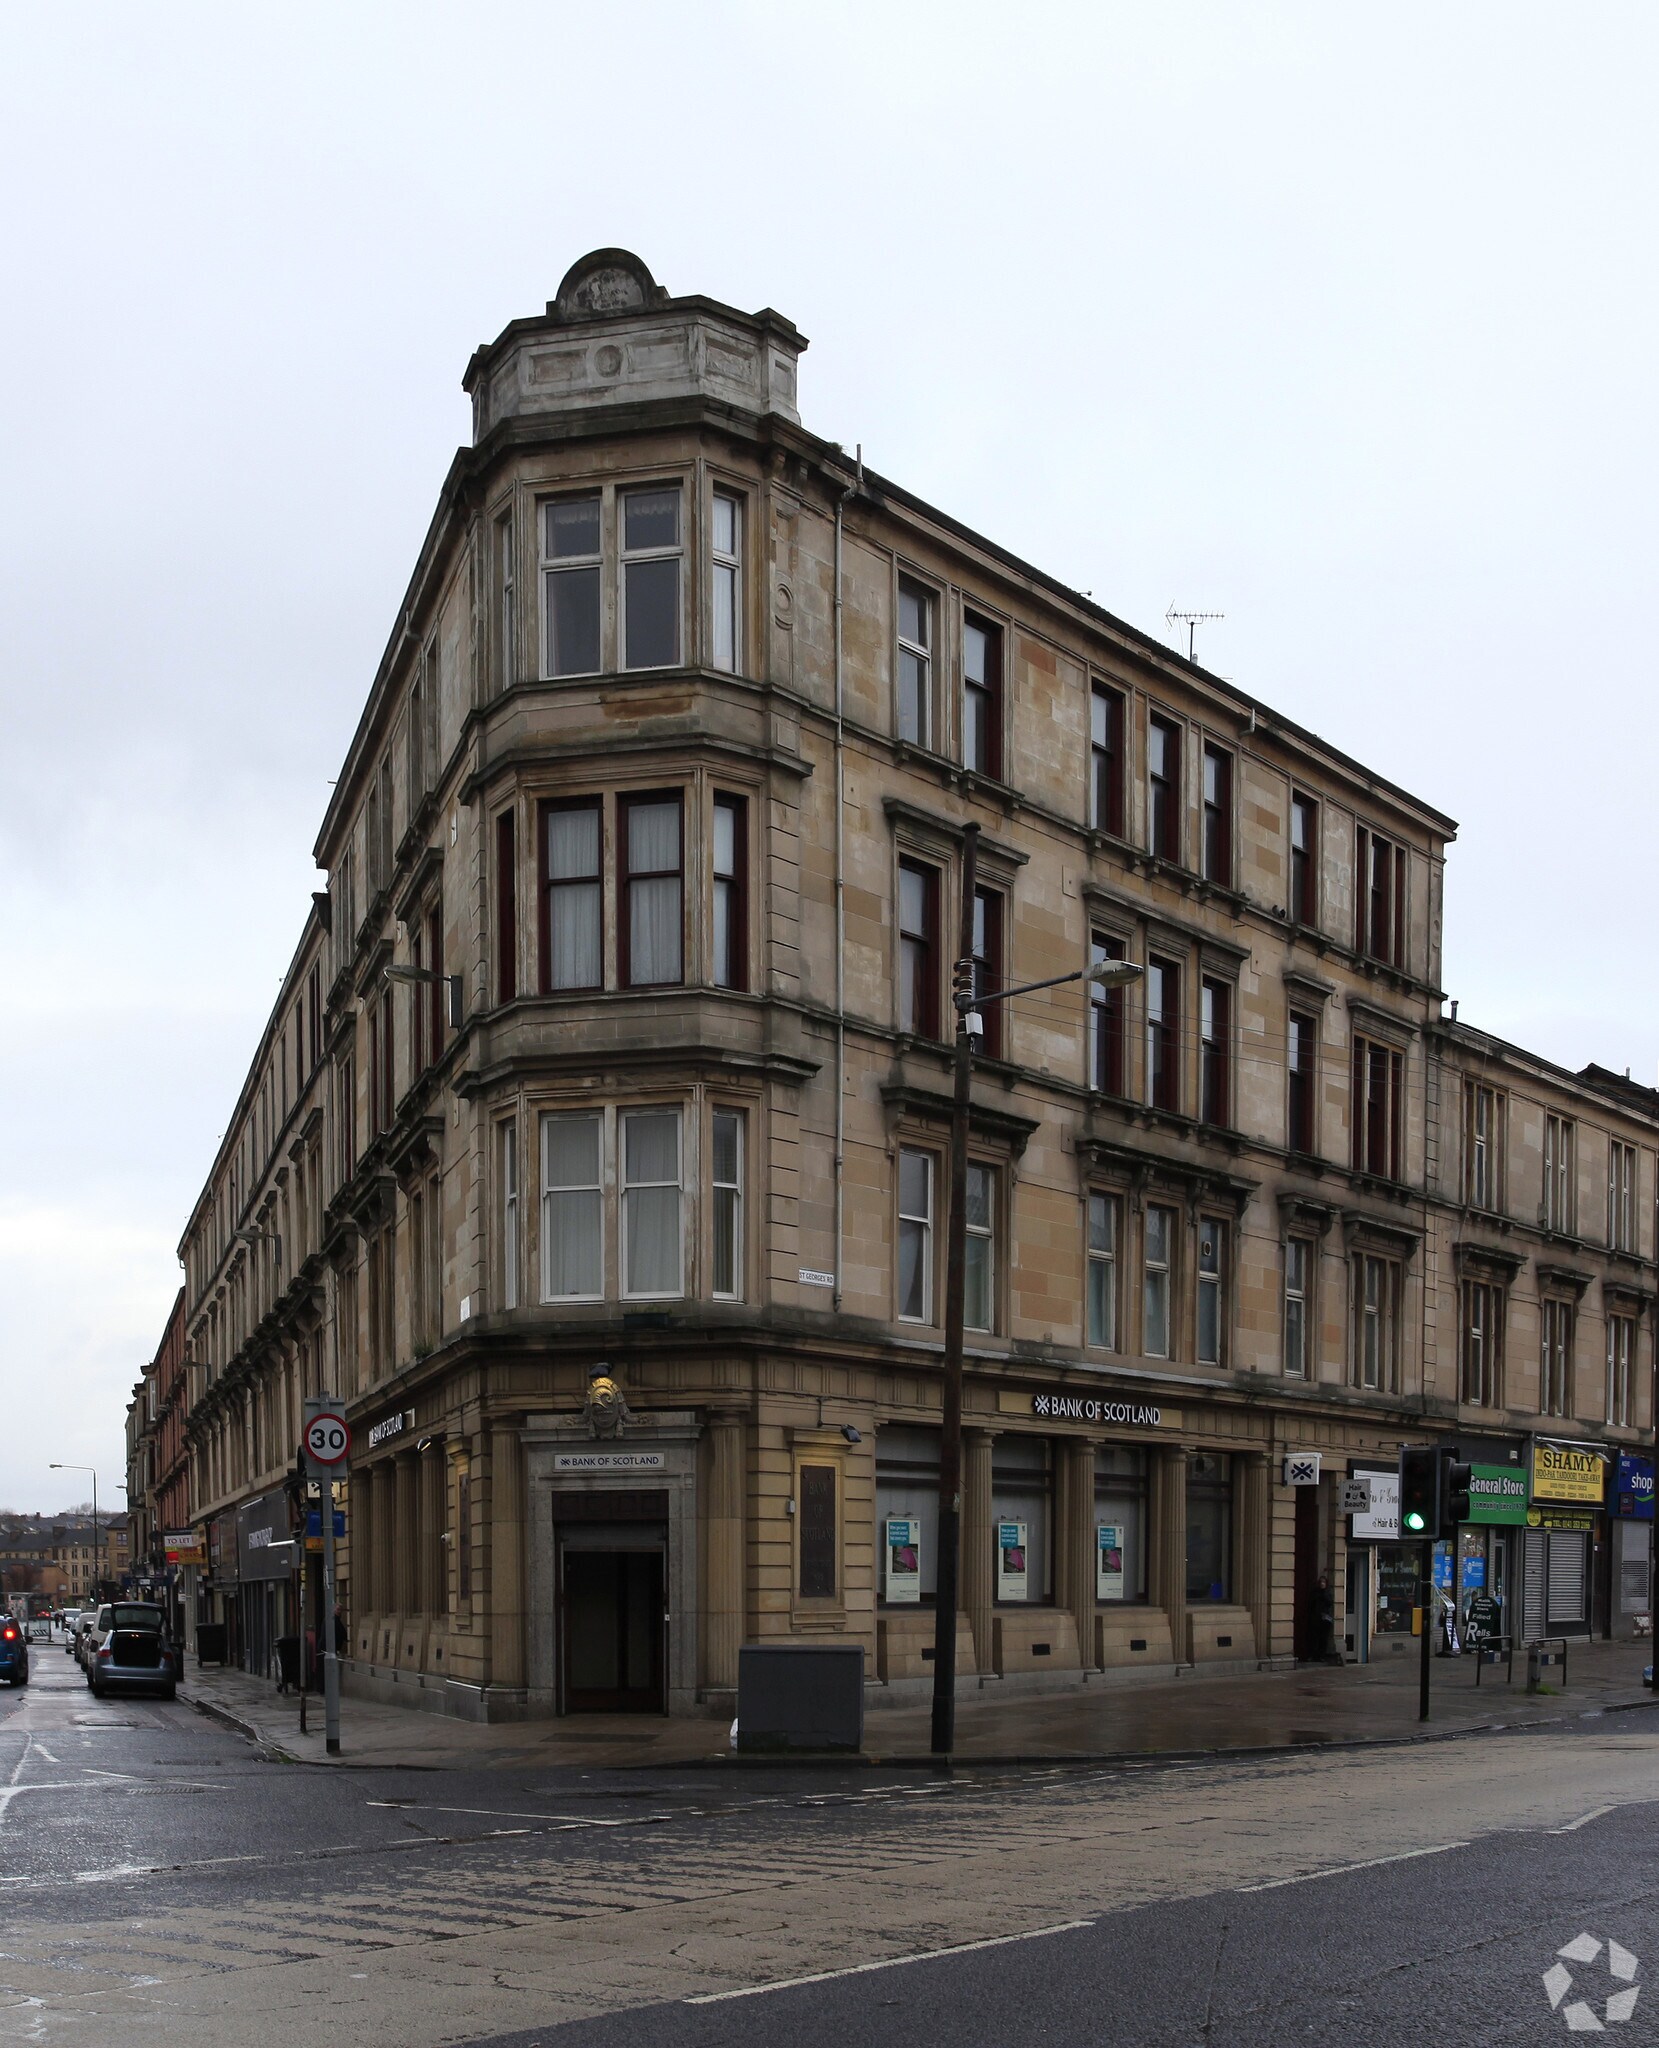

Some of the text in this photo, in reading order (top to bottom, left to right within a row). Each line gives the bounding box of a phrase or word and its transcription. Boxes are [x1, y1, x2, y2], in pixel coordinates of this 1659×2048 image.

[806, 1272, 826, 1282] GEORGES
[827, 1275, 834, 1284] RD
[1051, 1396, 1160, 1425] BANK OF SCOTLAND
[311, 1428, 344, 1449] 30
[572, 1456, 659, 1466] BANK OF SCOTLAND
[1543, 1451, 1594, 1472] SHAMY
[1470, 1474, 1501, 1495] General
[1502, 1476, 1525, 1496] Store
[1344, 1501, 1366, 1509] Beauty
[1472, 1501, 1499, 1512] community
[1500, 1501, 1512, 1511] since
[1377, 1518, 1388, 1528] Hair
[1389, 1518, 1393, 1528] &
